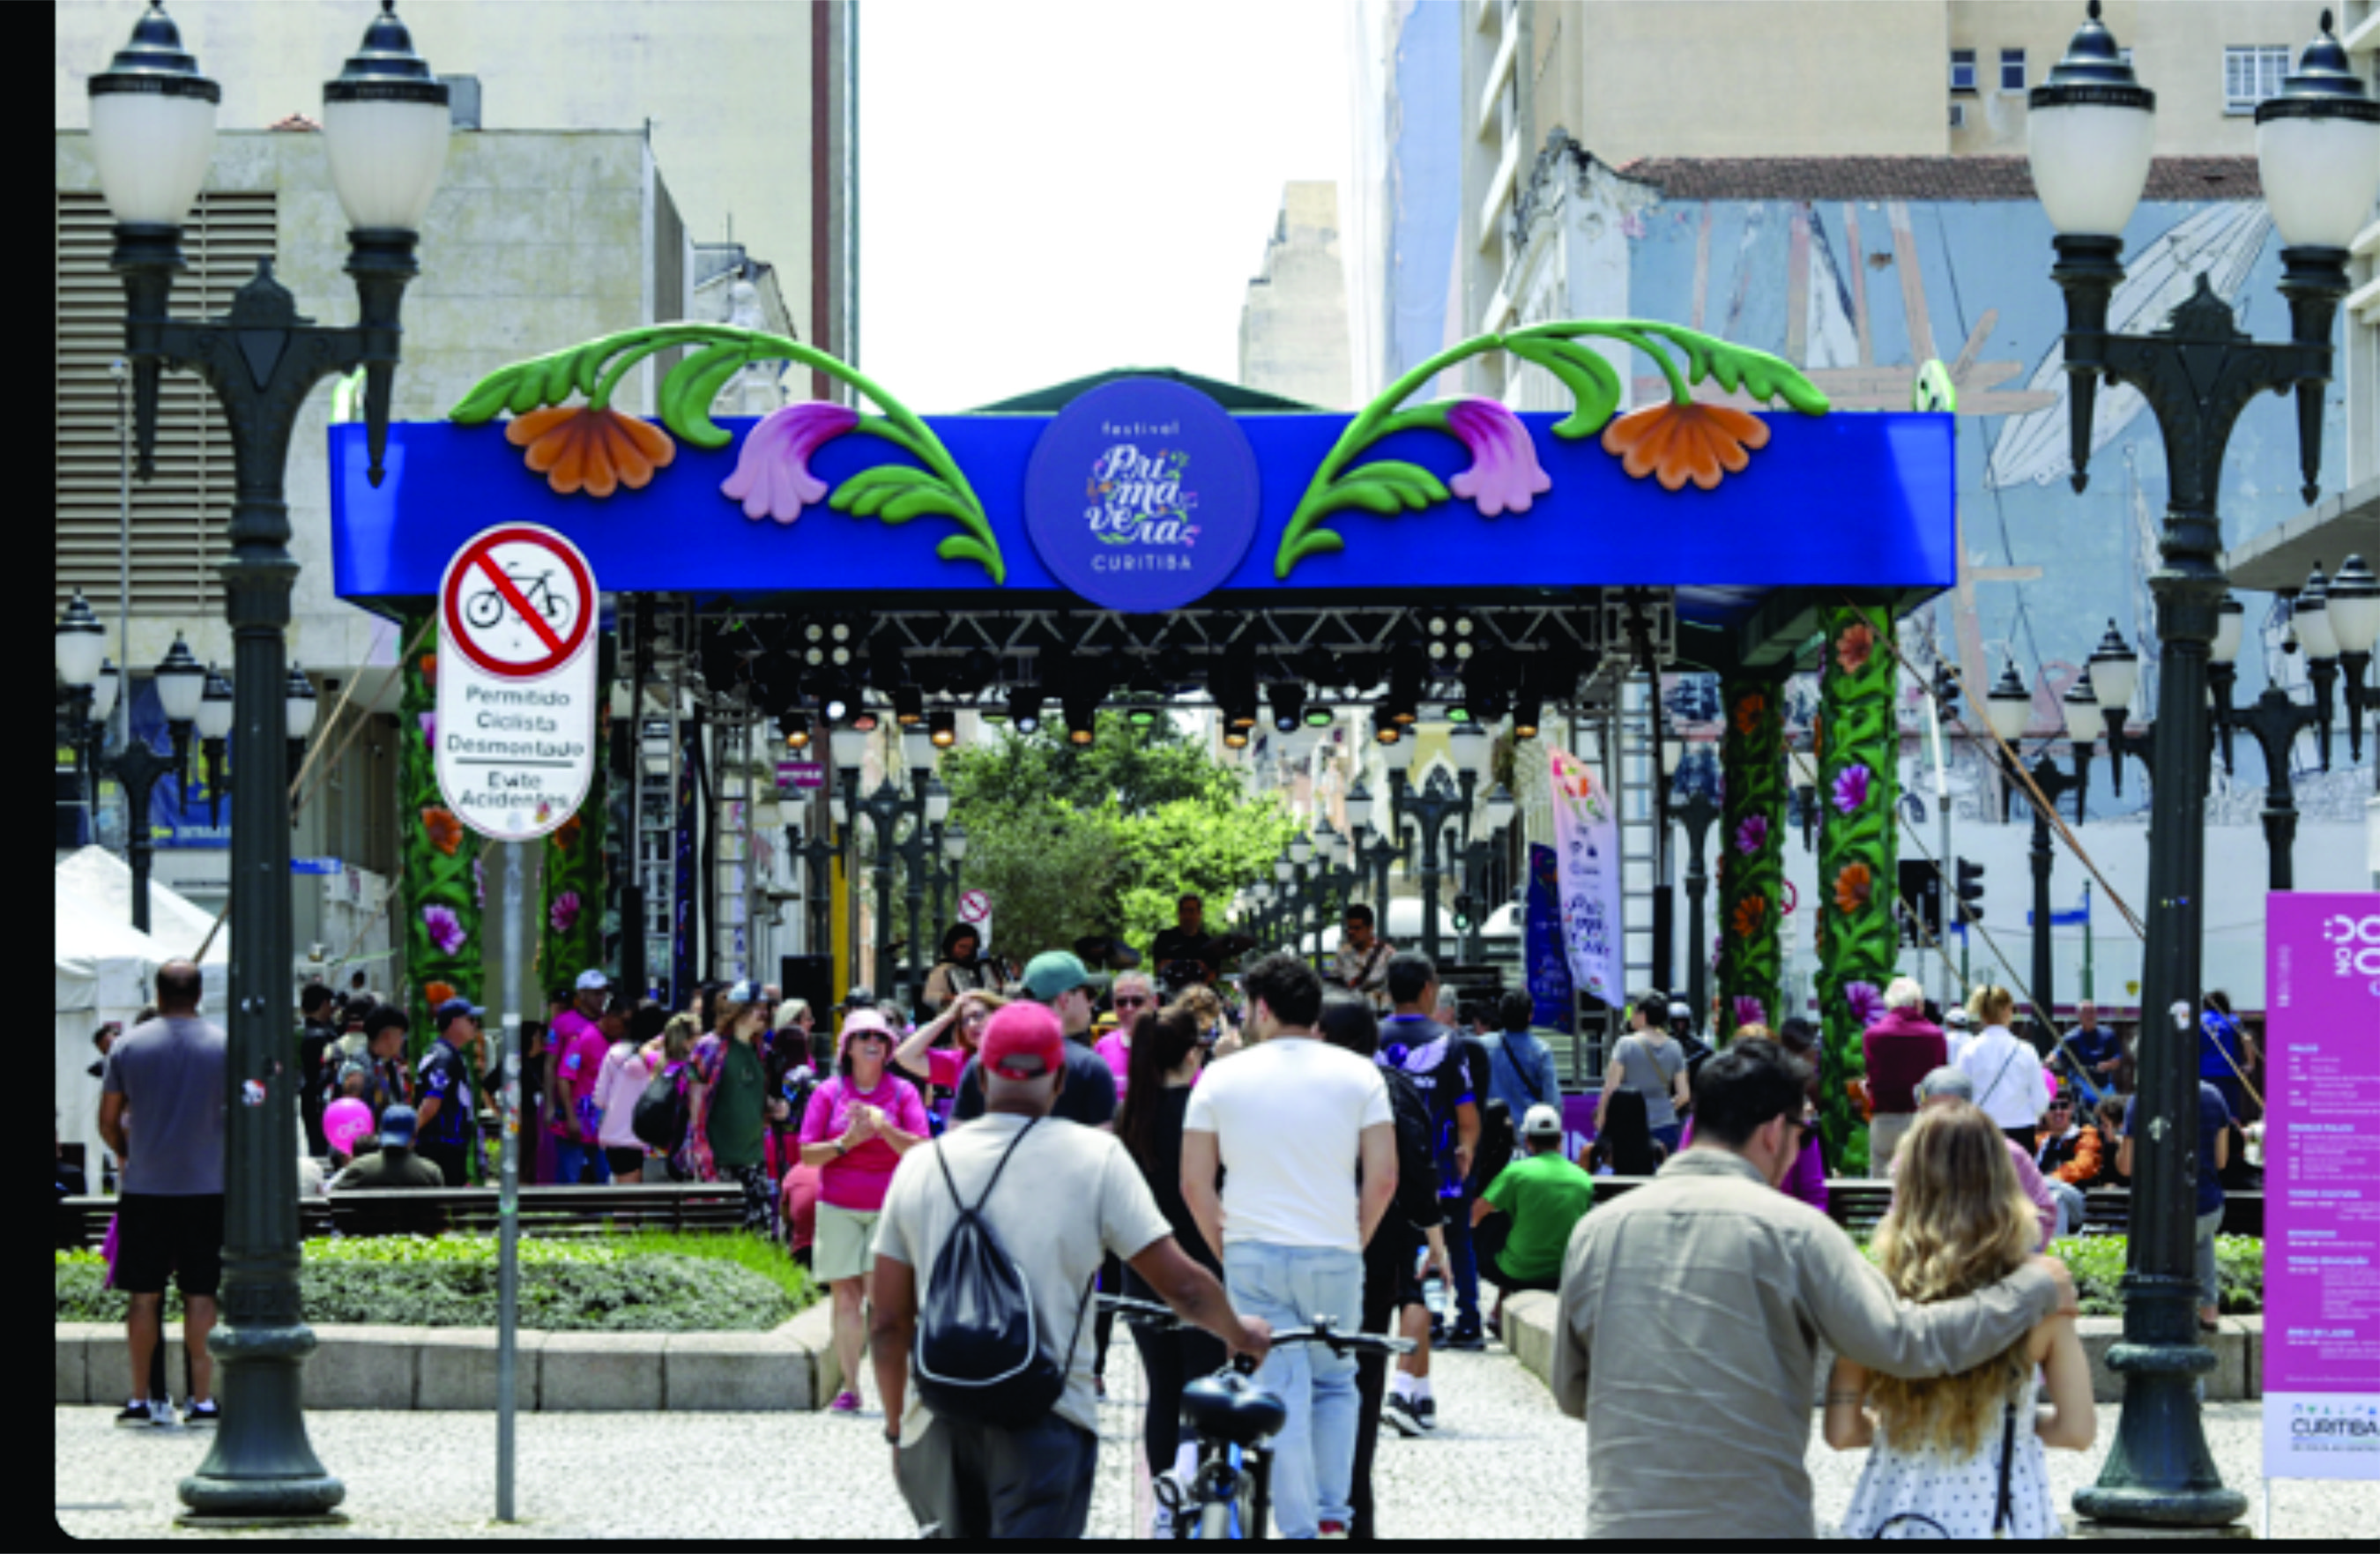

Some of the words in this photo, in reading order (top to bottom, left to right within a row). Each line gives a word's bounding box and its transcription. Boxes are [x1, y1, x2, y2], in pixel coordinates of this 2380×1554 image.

[1091, 554, 1193, 571] CURITIBA
[465, 685, 570, 706] Permitido
[476, 711, 558, 732] Ciclista
[447, 734, 584, 757] Desmontado
[488, 771, 542, 791] Evite
[459, 790, 569, 809] Acidentes
